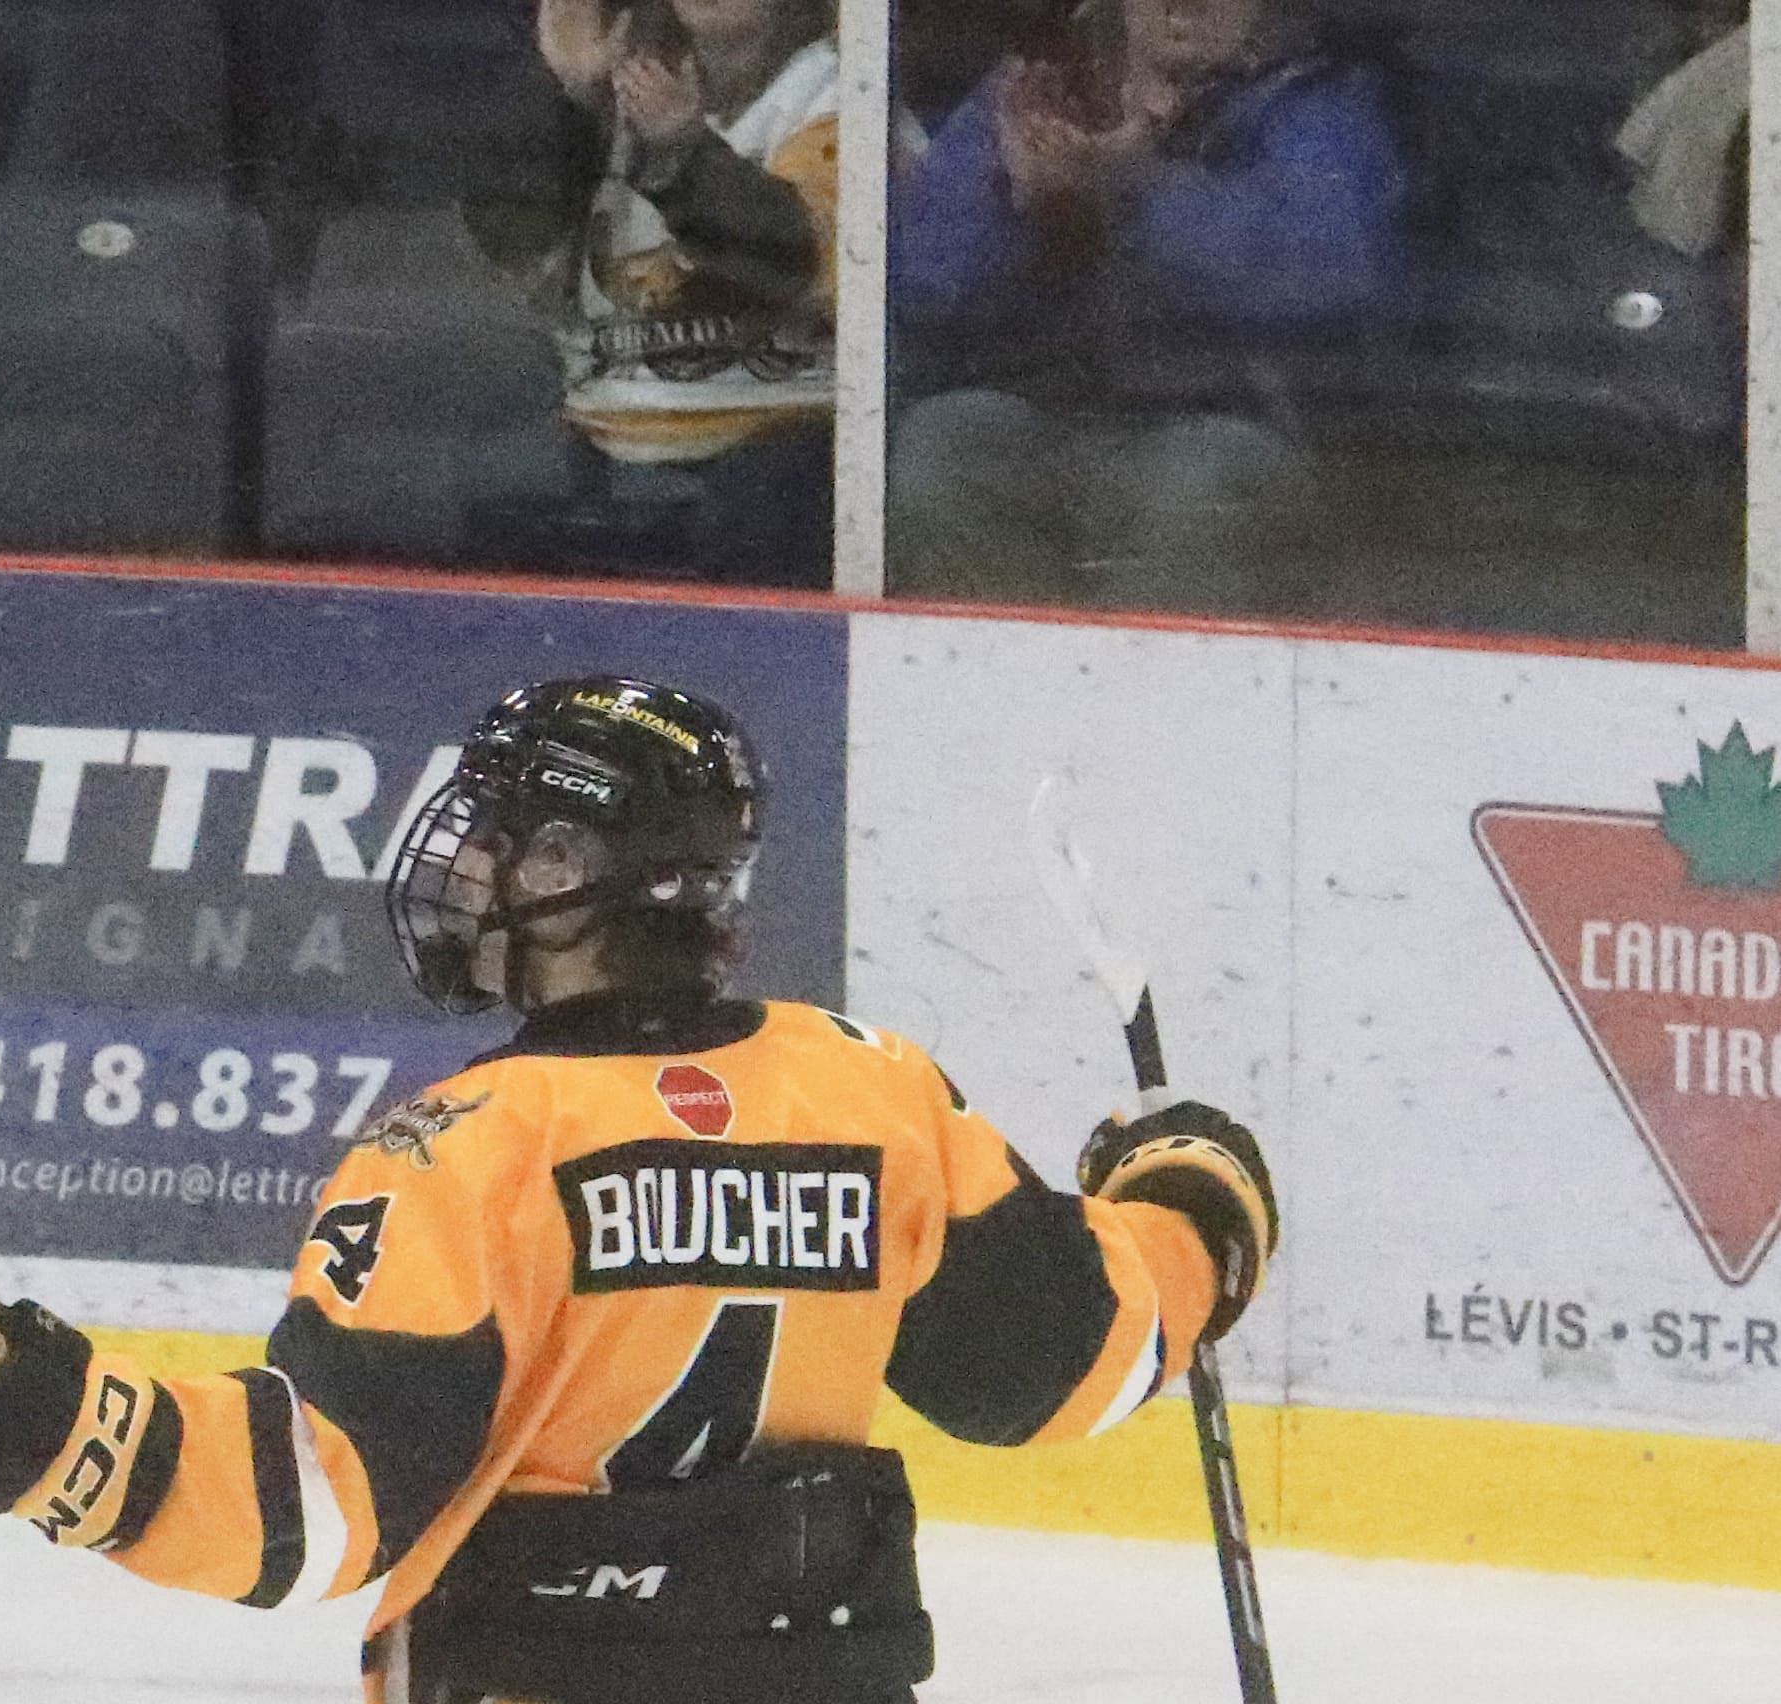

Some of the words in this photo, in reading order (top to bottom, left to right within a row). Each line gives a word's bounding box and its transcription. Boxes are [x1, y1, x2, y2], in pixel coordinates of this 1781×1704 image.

[541, 769, 613, 805] CCM
[305, 1193, 395, 1307] 4
[581, 1166, 873, 1272] BOUCHER
[1424, 1281, 1589, 1351] LÉVIS
[596, 1296, 786, 1492] 4
[29, 1374, 138, 1537] CCM
